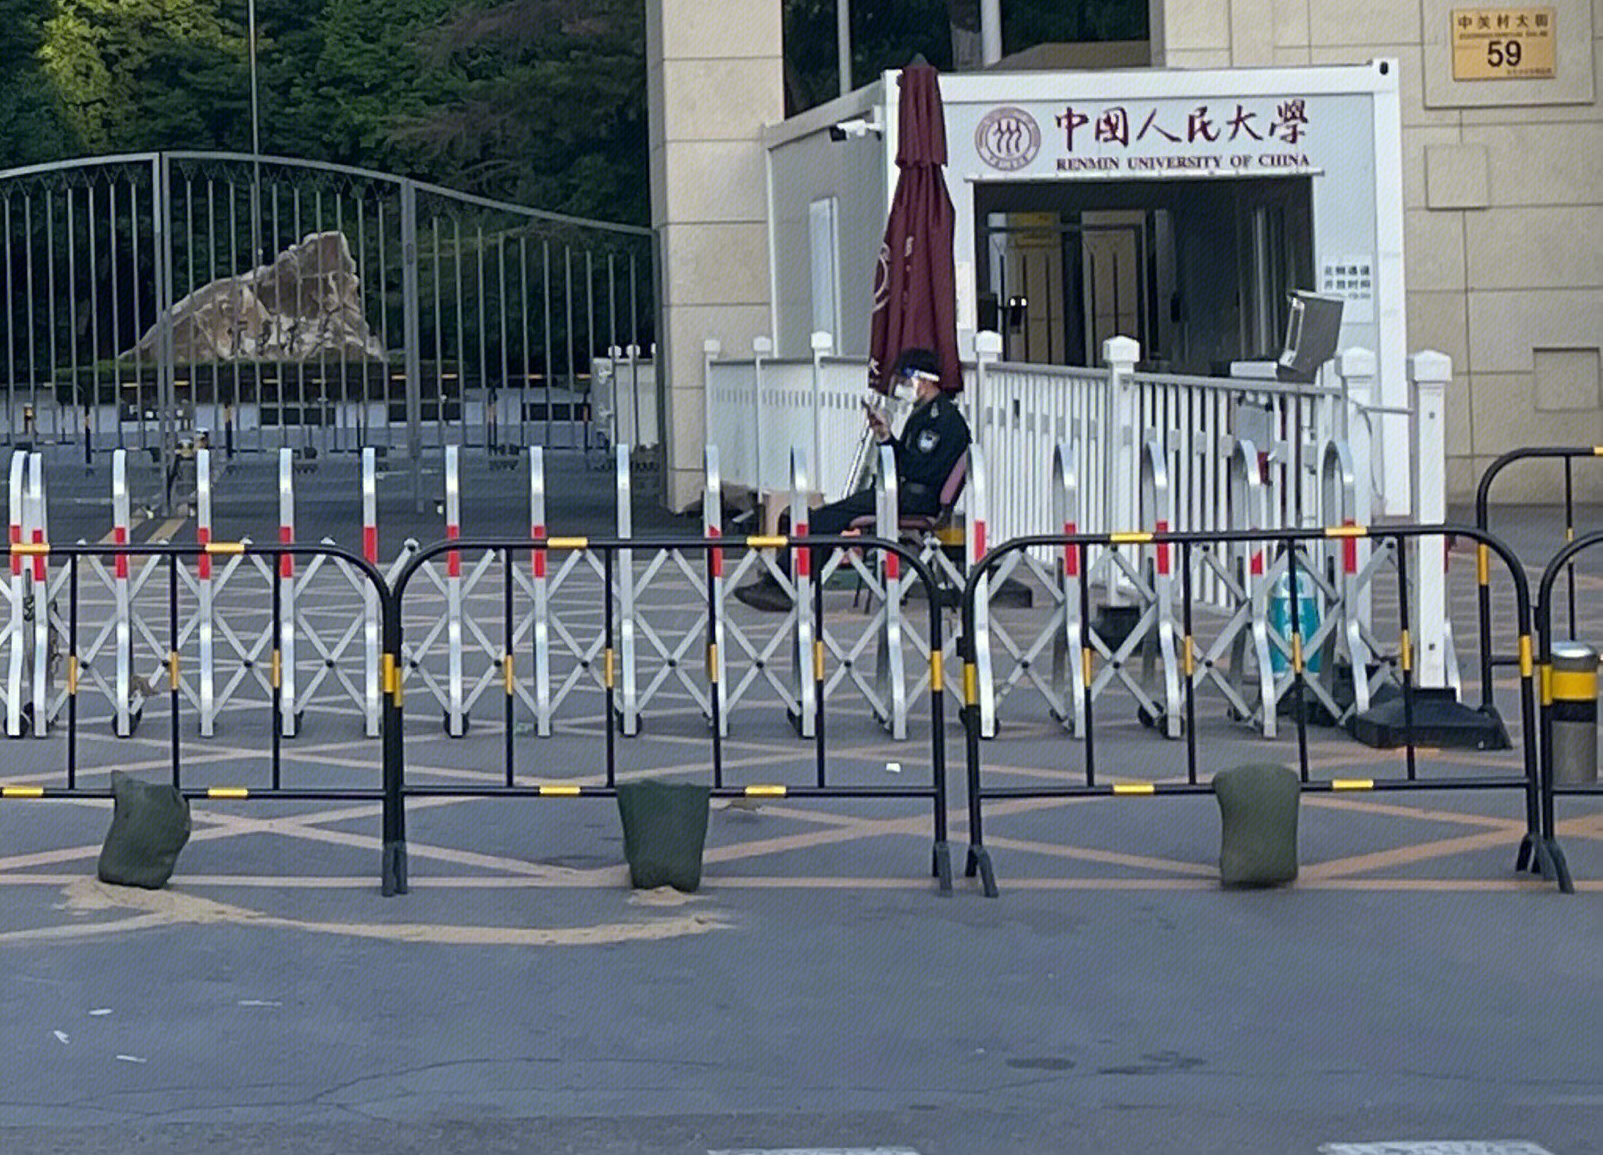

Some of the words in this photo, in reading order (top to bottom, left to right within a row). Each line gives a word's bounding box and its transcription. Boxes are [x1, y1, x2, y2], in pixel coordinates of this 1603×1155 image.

[1487, 40, 1522, 67] 59
[1055, 99, 1308, 152] 中國人民大學
[1056, 156, 1119, 171] RENMIN
[1127, 154, 1221, 170] UNIVERSITY
[1230, 154, 1251, 168] OF
[1258, 153, 1310, 168] CHINA
